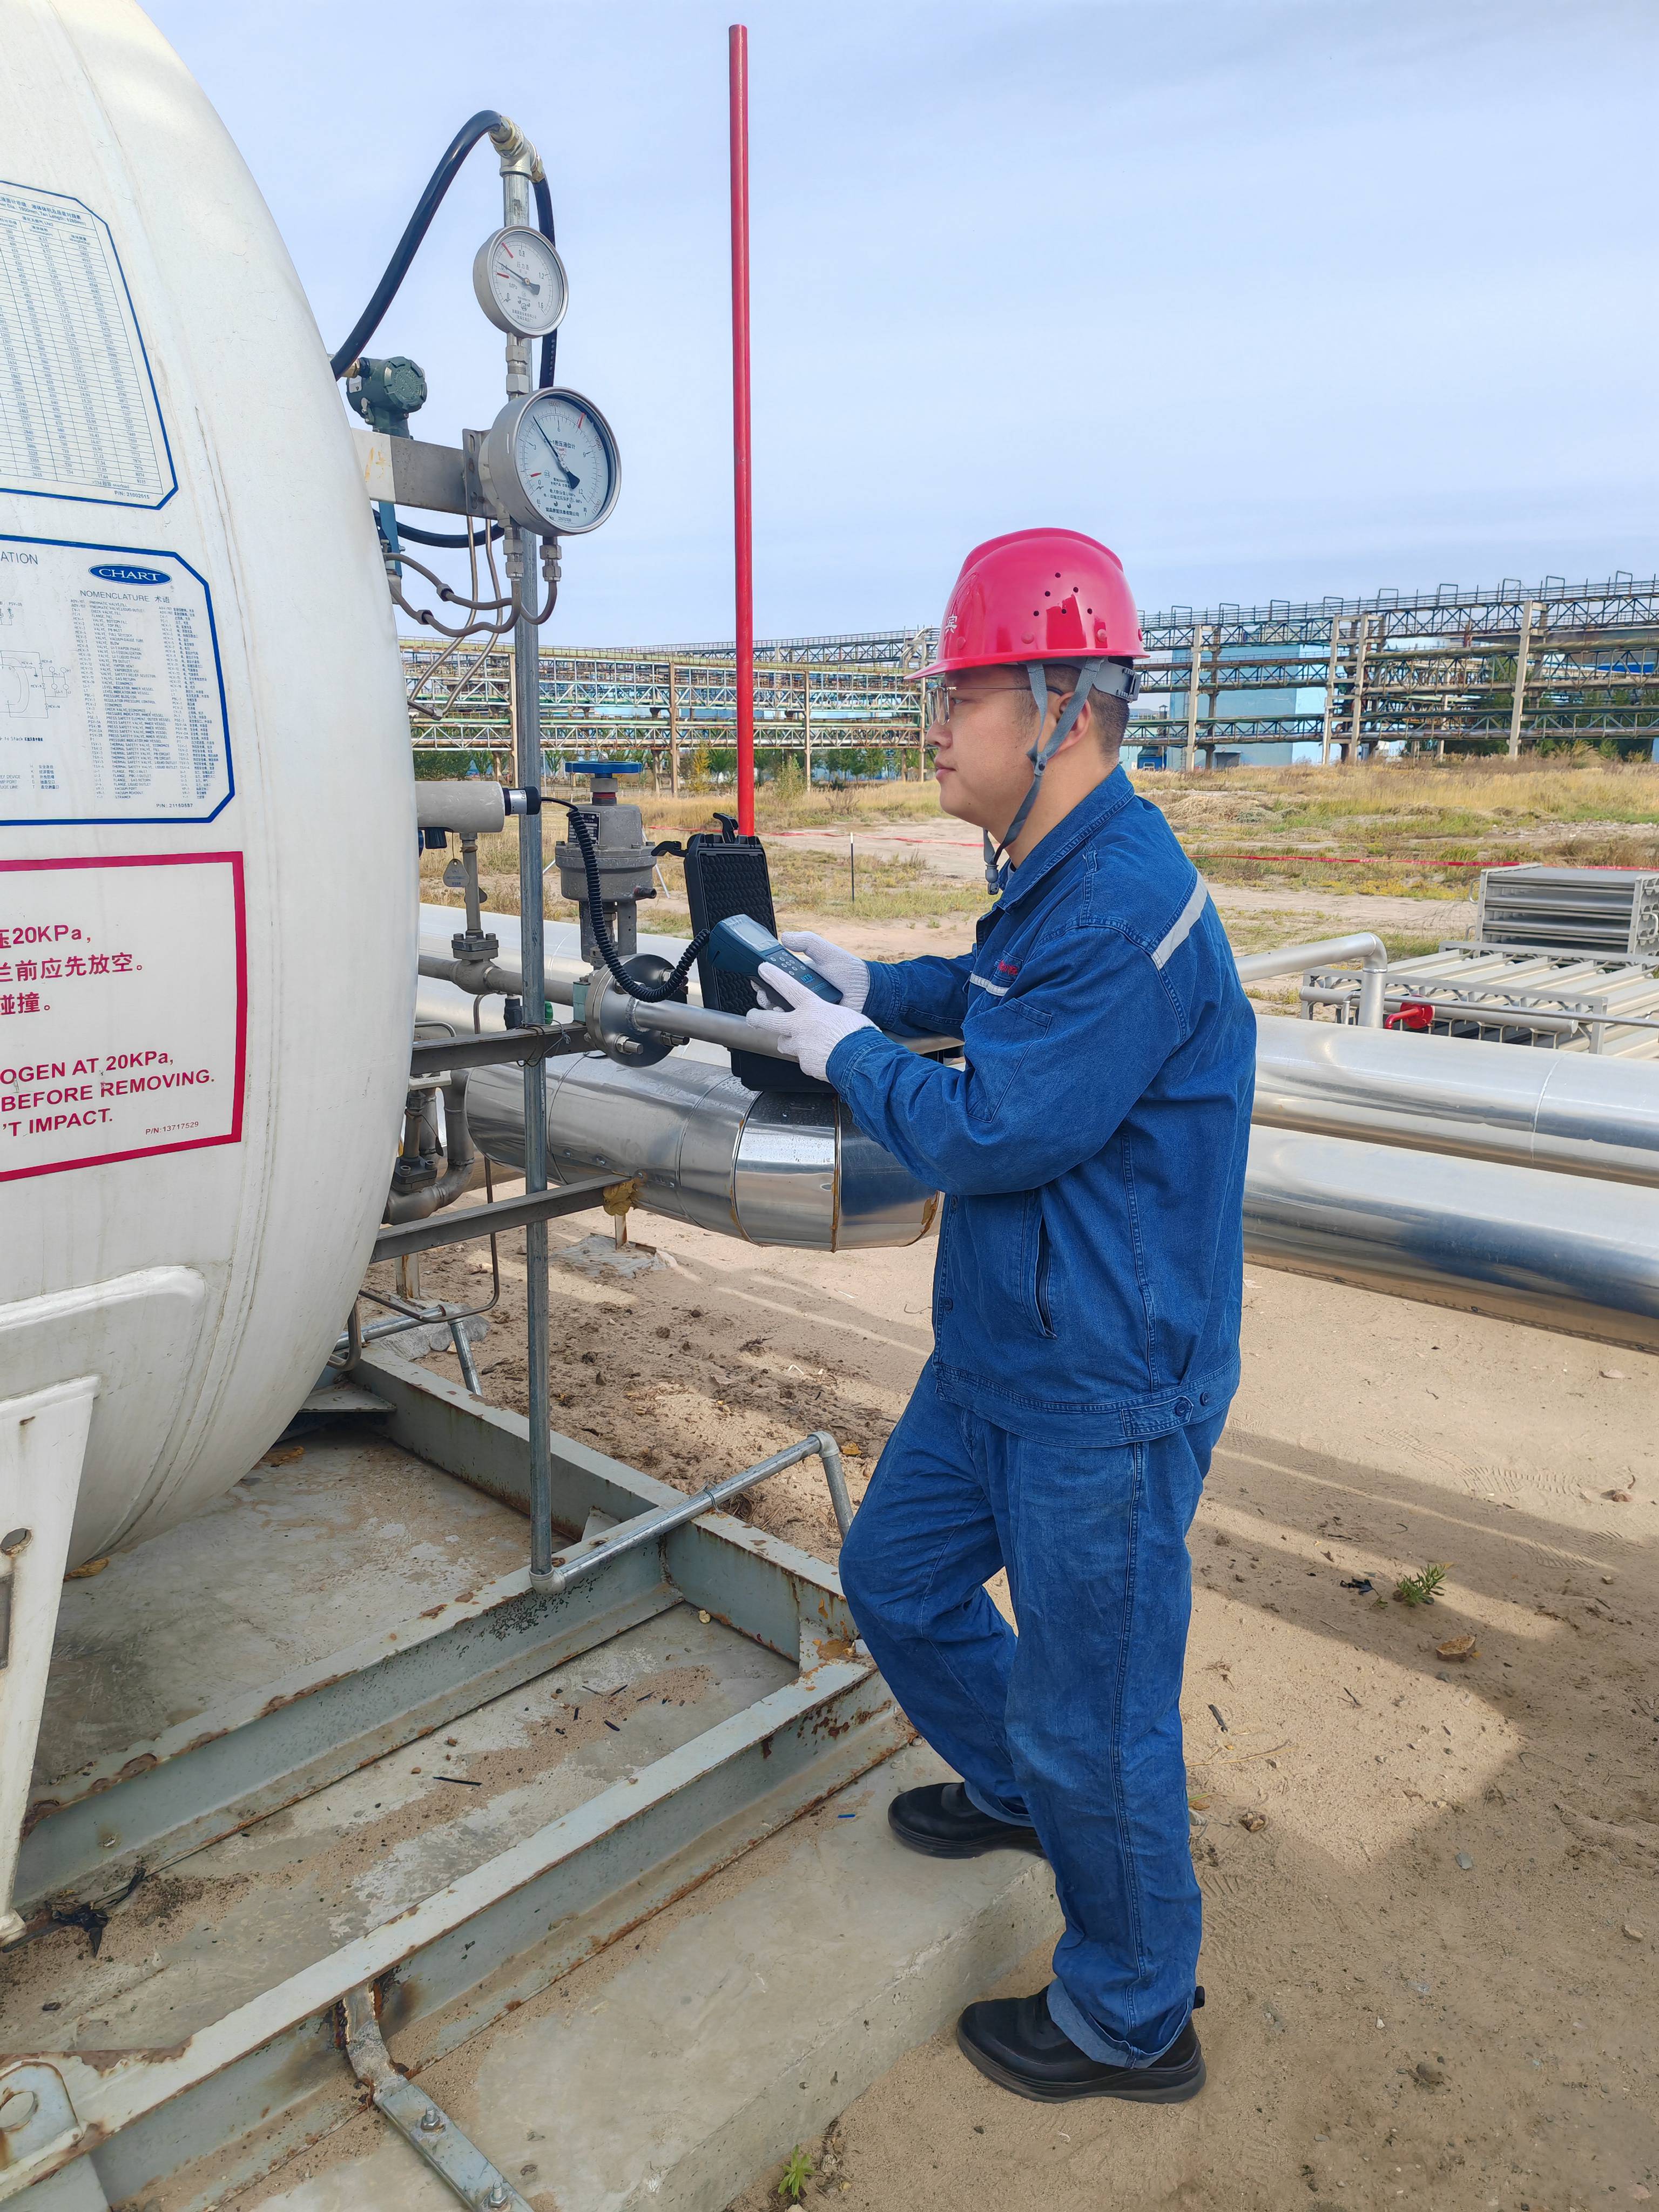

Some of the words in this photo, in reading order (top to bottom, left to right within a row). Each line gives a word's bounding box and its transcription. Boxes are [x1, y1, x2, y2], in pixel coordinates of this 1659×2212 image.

[1, 551, 38, 564] ATION
[99, 568, 161, 581] CHART
[80, 590, 150, 602] NOMENCLATURE
[0, 1062, 65, 1084] OGEN
[72, 1058, 99, 1075] AT
[106, 1051, 173, 1071] 20KPa,
[2, 1085, 93, 1112] BEFORE
[100, 1069, 214, 1097] REMOVING.
[29, 1108, 112, 1134] IMPACT.
